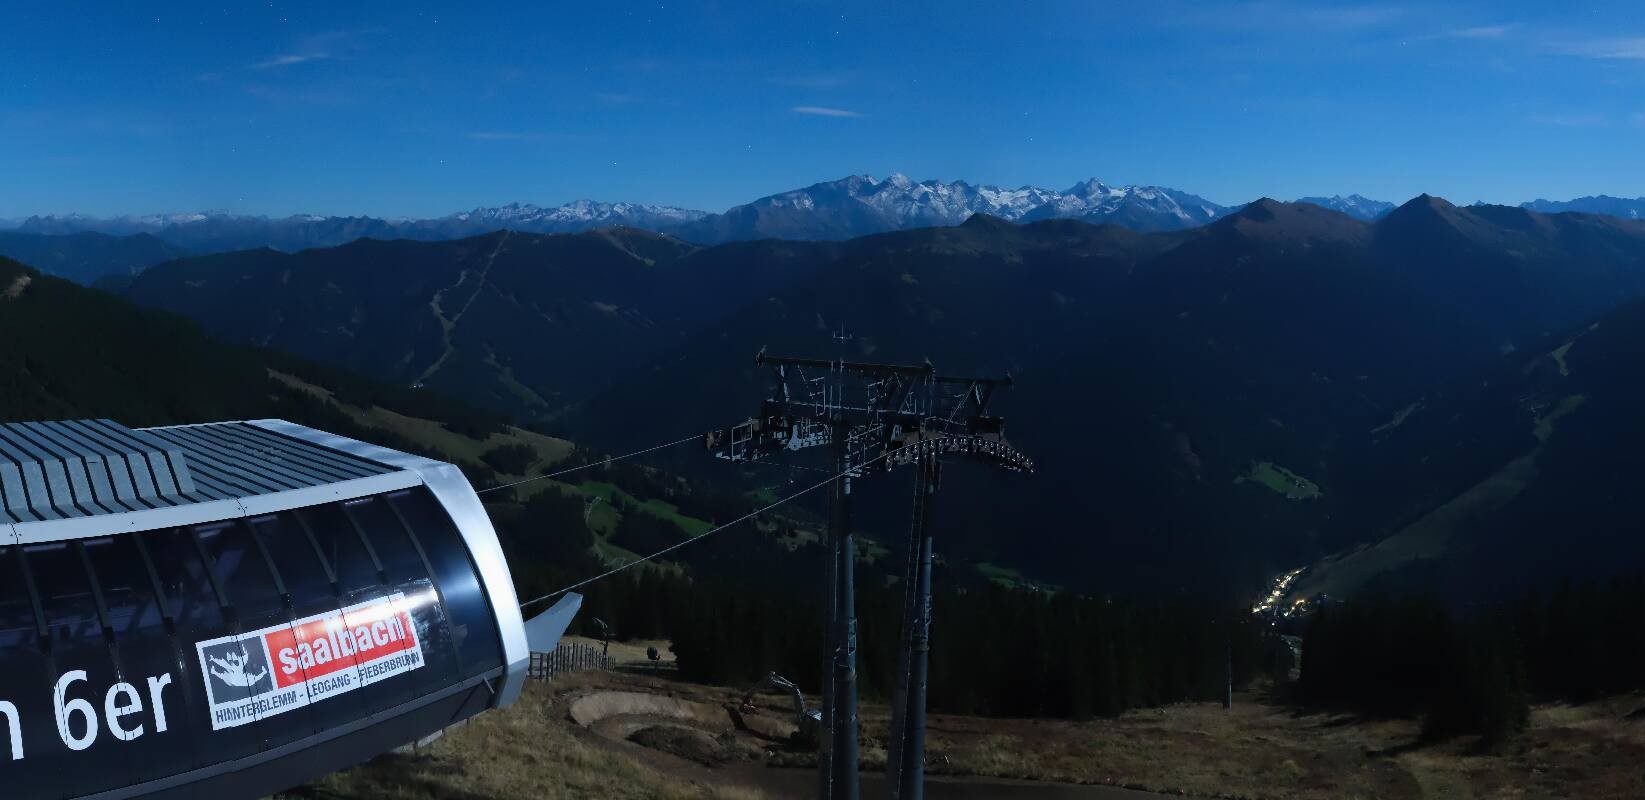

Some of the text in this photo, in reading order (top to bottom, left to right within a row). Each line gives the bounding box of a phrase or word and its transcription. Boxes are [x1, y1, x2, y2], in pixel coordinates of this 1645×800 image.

[278, 613, 406, 675] saalbach
[52, 668, 171, 752] 6er
[308, 673, 351, 698] LEOGANG
